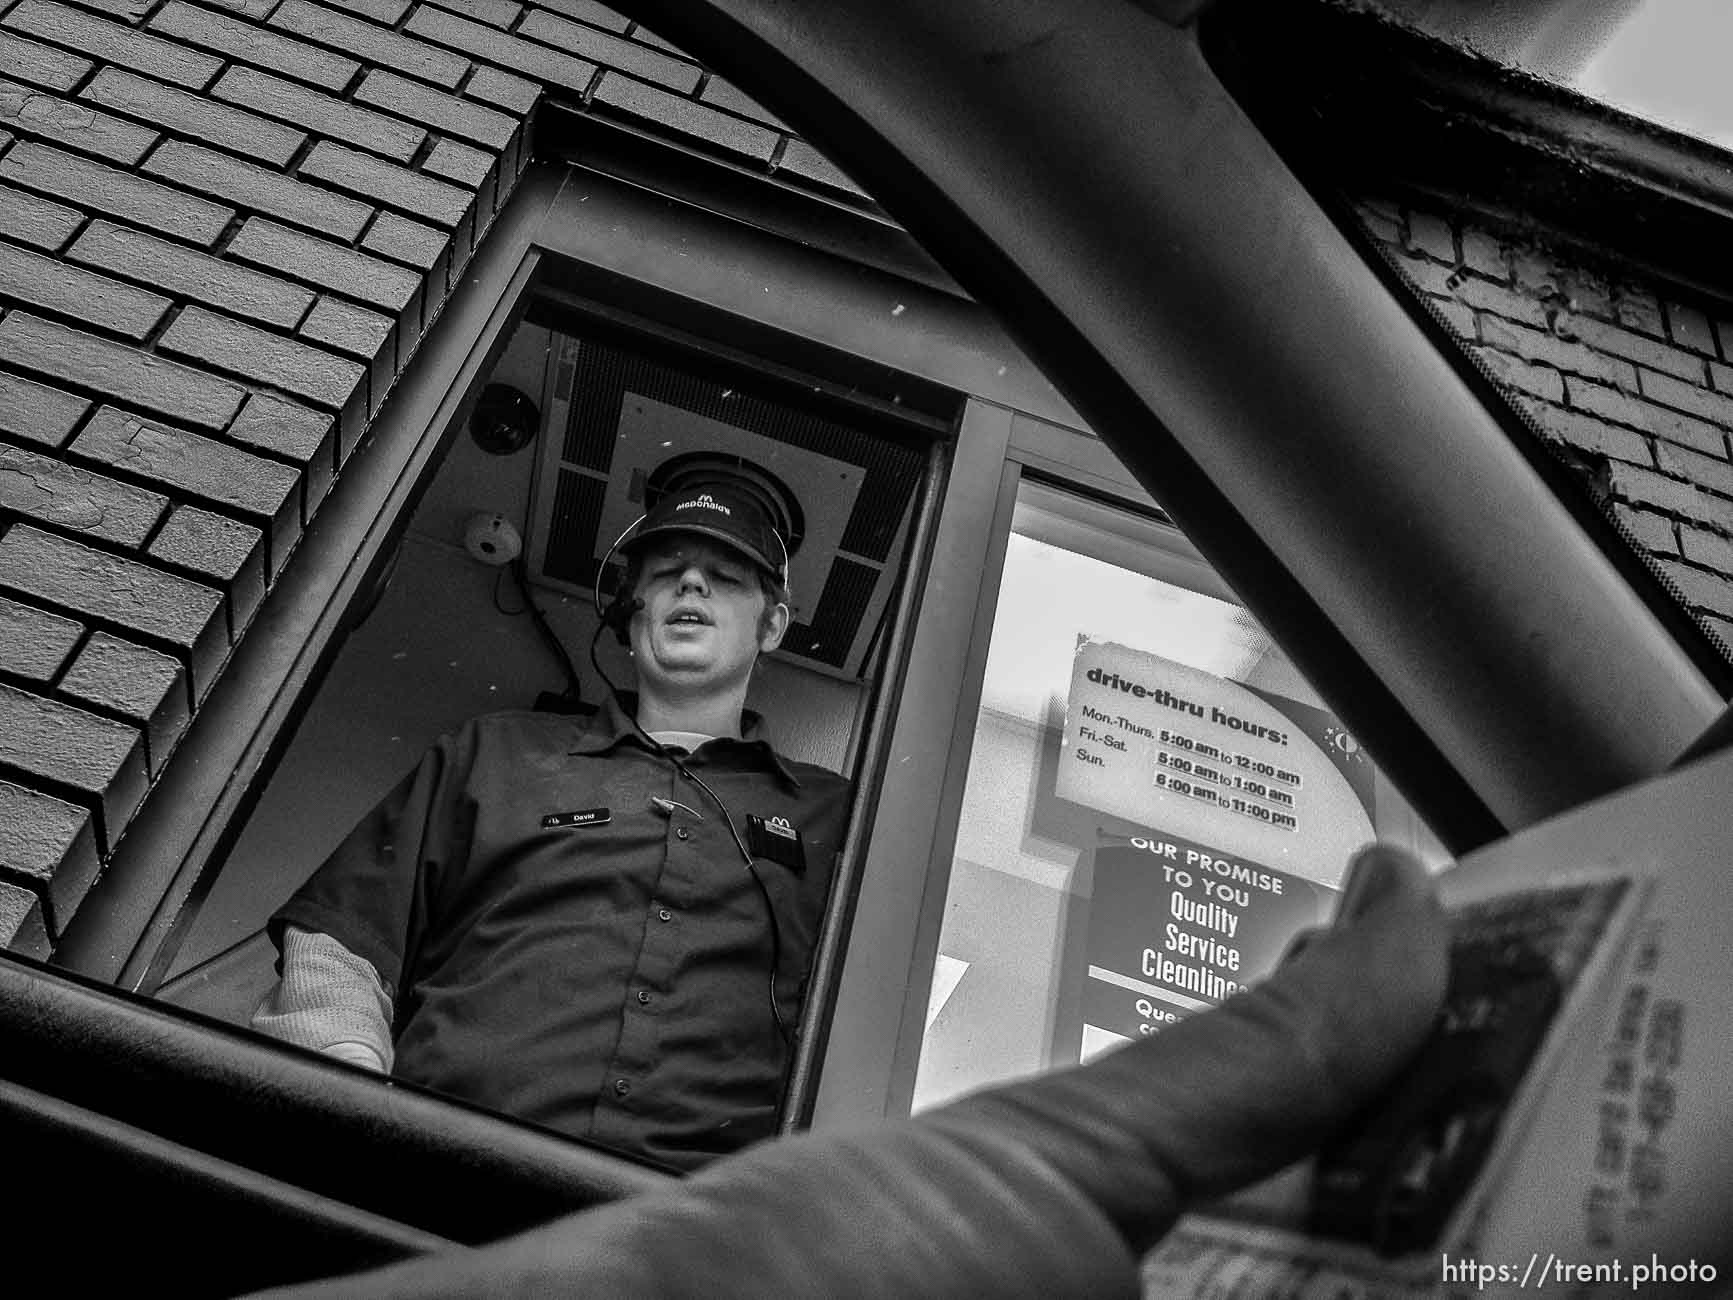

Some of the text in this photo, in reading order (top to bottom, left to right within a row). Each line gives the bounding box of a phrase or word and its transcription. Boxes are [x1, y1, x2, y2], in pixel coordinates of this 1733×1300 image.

[1086, 668, 1288, 747] drive-thru hours:
[1079, 726, 1293, 805] Fri.-Sat. 5:00 am to 1:00 am
[1082, 705, 1300, 785] Mon.-Thurs. 5:00 am to 12:00 am
[573, 812, 596, 822] David
[1076, 748, 1297, 828] Sun. 6:00 am to 11:00 pm
[1130, 837, 1284, 896] OUR PROMISE
[1163, 865, 1249, 907] TO YOU
[1170, 890, 1239, 938] Quality
[1165, 922, 1240, 971] Service
